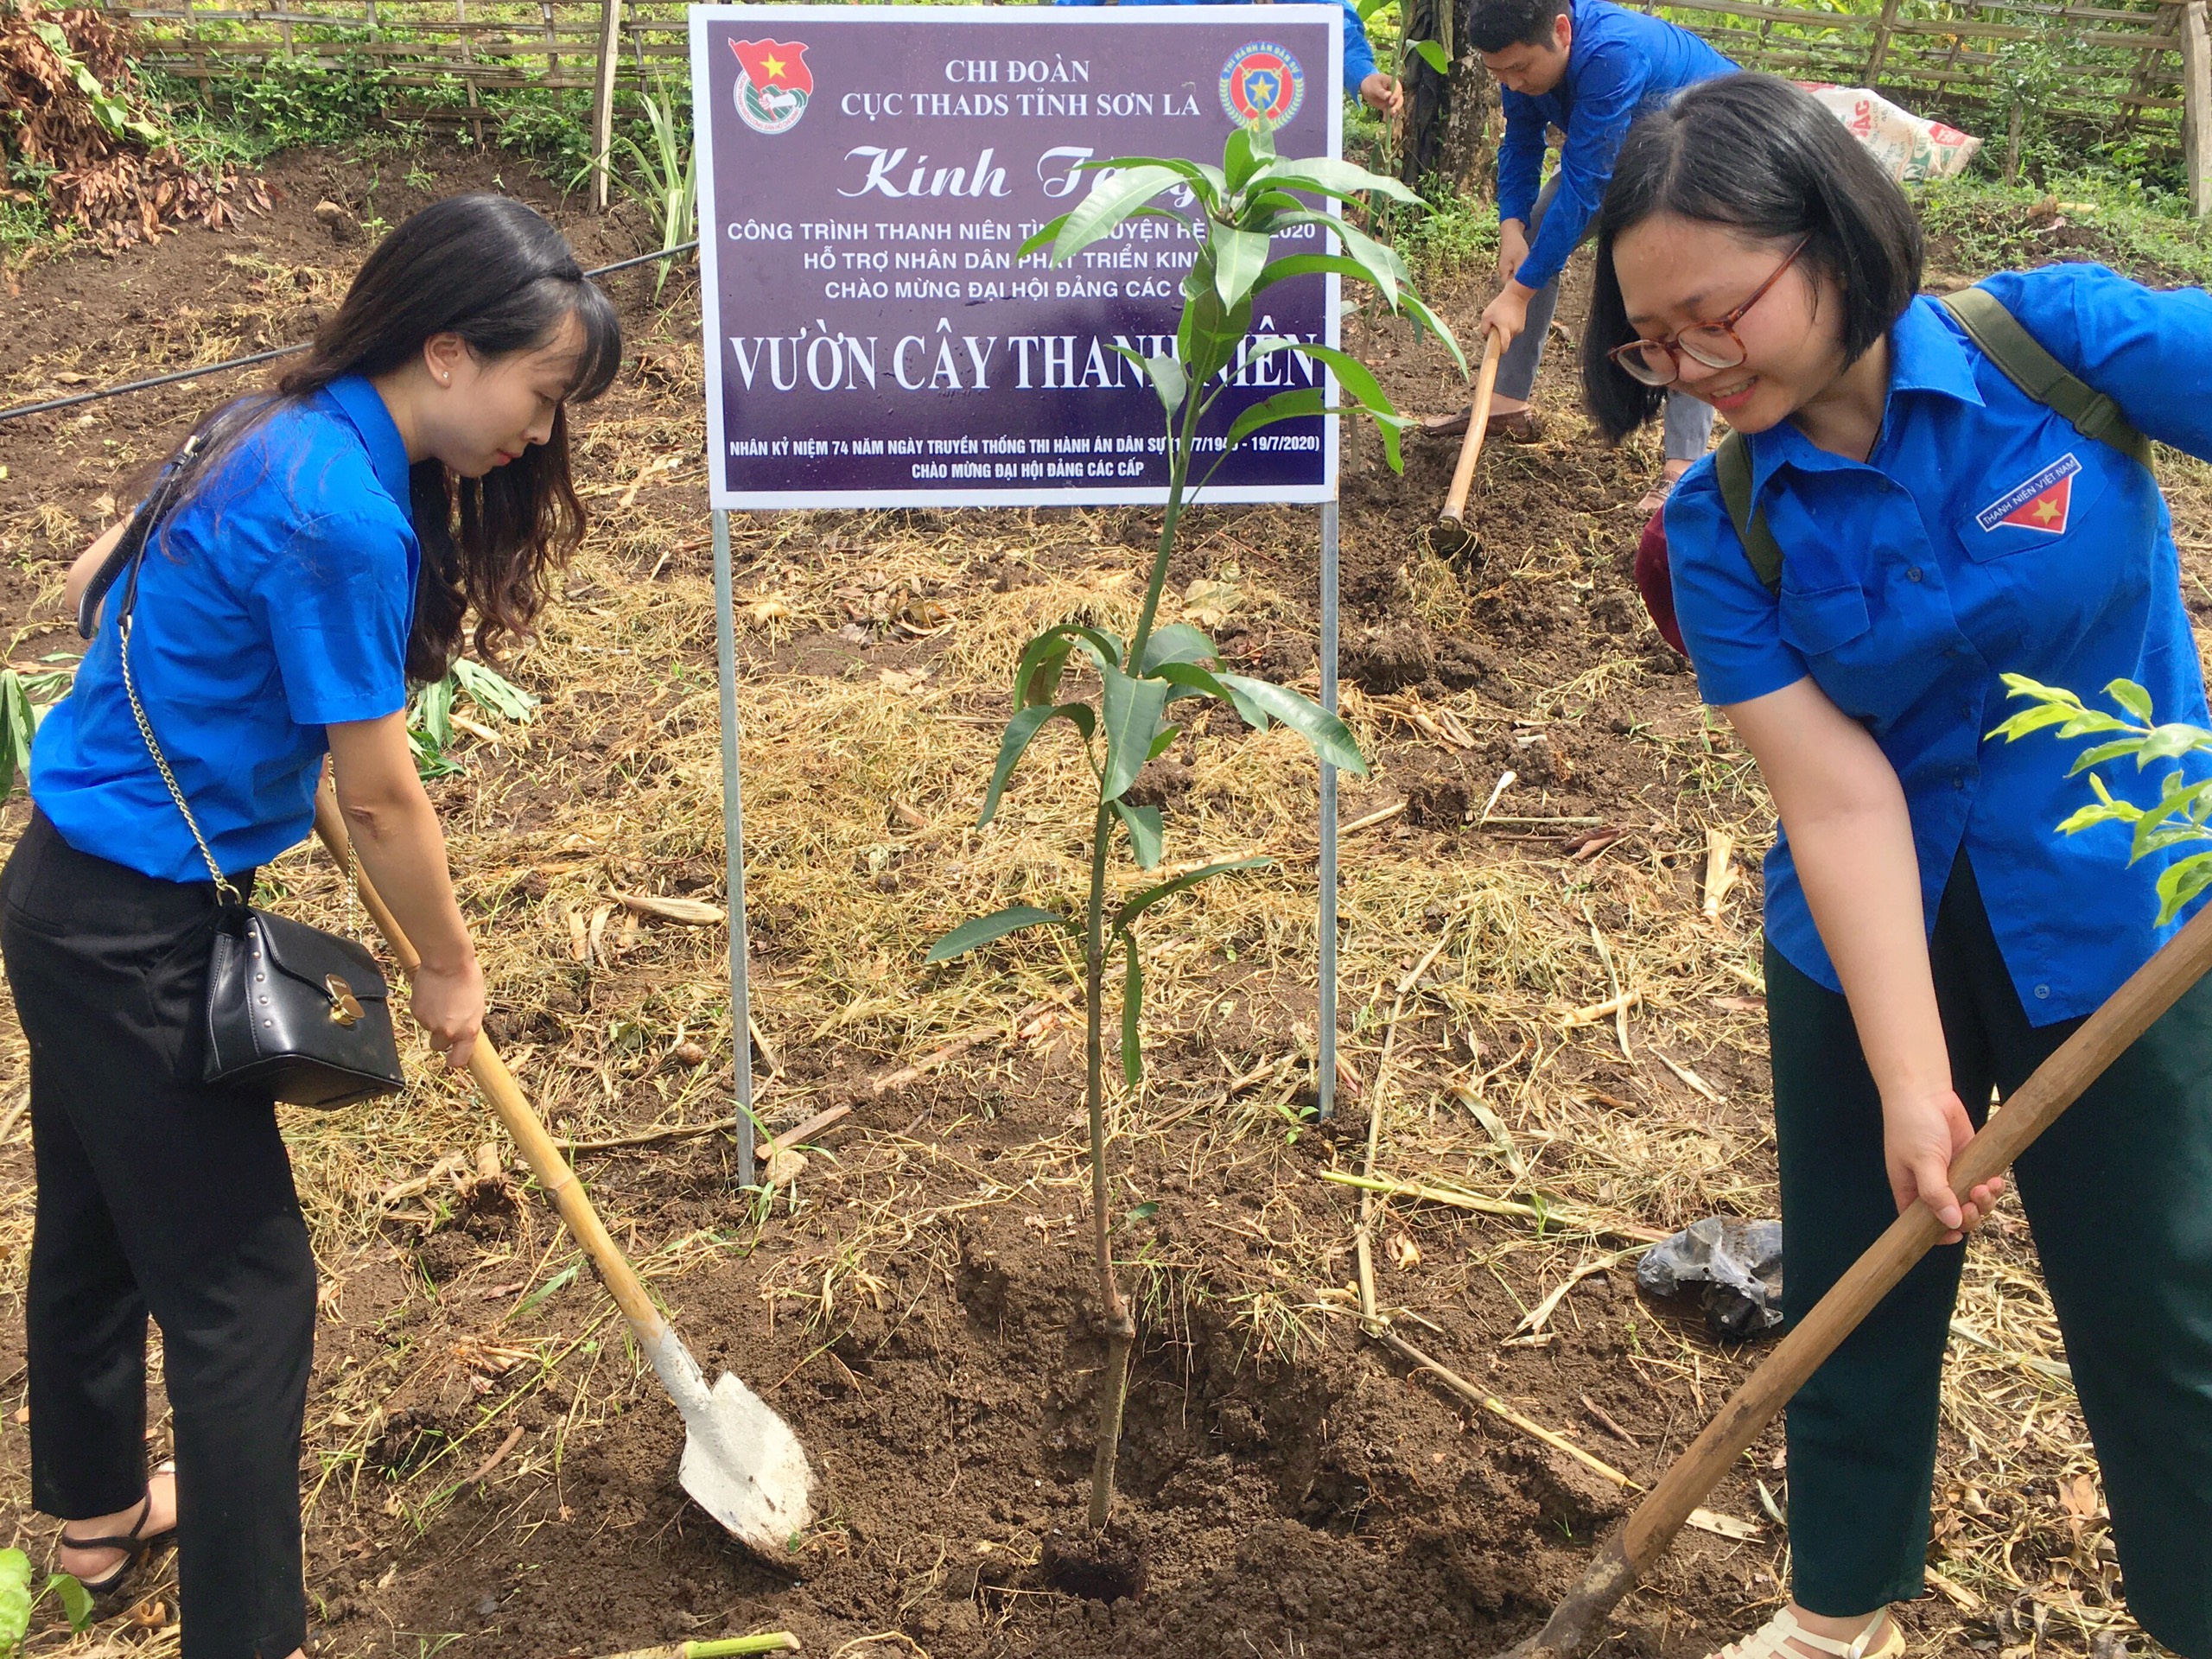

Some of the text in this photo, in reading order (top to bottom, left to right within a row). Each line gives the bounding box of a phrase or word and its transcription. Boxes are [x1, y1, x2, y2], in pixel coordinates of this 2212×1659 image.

[945, 53, 1090, 83] CHI ĐOÀN
[1224, 59, 1236, 73] THI
[841, 88, 1201, 121] CỤC THADS TỈNH SƠN LA
[836, 146, 1013, 198] Kính
[728, 219, 793, 240] CÔNG
[800, 219, 868, 240] TRÌNH
[875, 223, 951, 240] THANH
[959, 219, 1011, 240] NIÊN
[1018, 219, 1054, 240] TÌ
[1093, 219, 1167, 243] UYỆN
[1177, 219, 1206, 239] HÈ
[804, 245, 836, 270] HỖ
[842, 251, 889, 272] TRỢ
[895, 249, 957, 270] NHÂN
[965, 249, 1010, 270] DÂN
[1083, 243, 1149, 269] TRIỂN
[824, 277, 888, 298] CHÀO
[895, 277, 961, 298] MỪNG
[968, 282, 1005, 302] ĐẠI
[1011, 277, 1049, 302] HỘI
[1056, 275, 1118, 297] ĐẢNG
[1125, 276, 1172, 297] CÁC
[728, 318, 878, 391] VƯỜN
[893, 317, 997, 391] CÂY
[1204, 315, 1318, 388] IÊN
[729, 438, 768, 456] NHÂN
[772, 436, 790, 455] KỶ
[792, 438, 829, 459] NIỆM
[831, 440, 849, 455] 74
[852, 436, 884, 455] NĂM
[887, 437, 924, 454] NGÀY
[927, 435, 979, 454] TRUYỀN
[982, 434, 1026, 454] THỐNG
[1029, 438, 1051, 454] THI
[1053, 435, 1090, 454] HÀNH
[1094, 435, 1113, 454] ÁN
[1116, 435, 1144, 453] DÂN
[1147, 435, 1167, 455] SỰ
[1251, 435, 1319, 451] 19/7/2020)
[911, 456, 1145, 481] CHÀO MỪNG ĐẠI HỘI ĐẢNG CÁC CẤP
[1982, 502, 2012, 524] THANH
[2035, 473, 2056, 490] VIỆT
[2056, 460, 2075, 476] NAM
